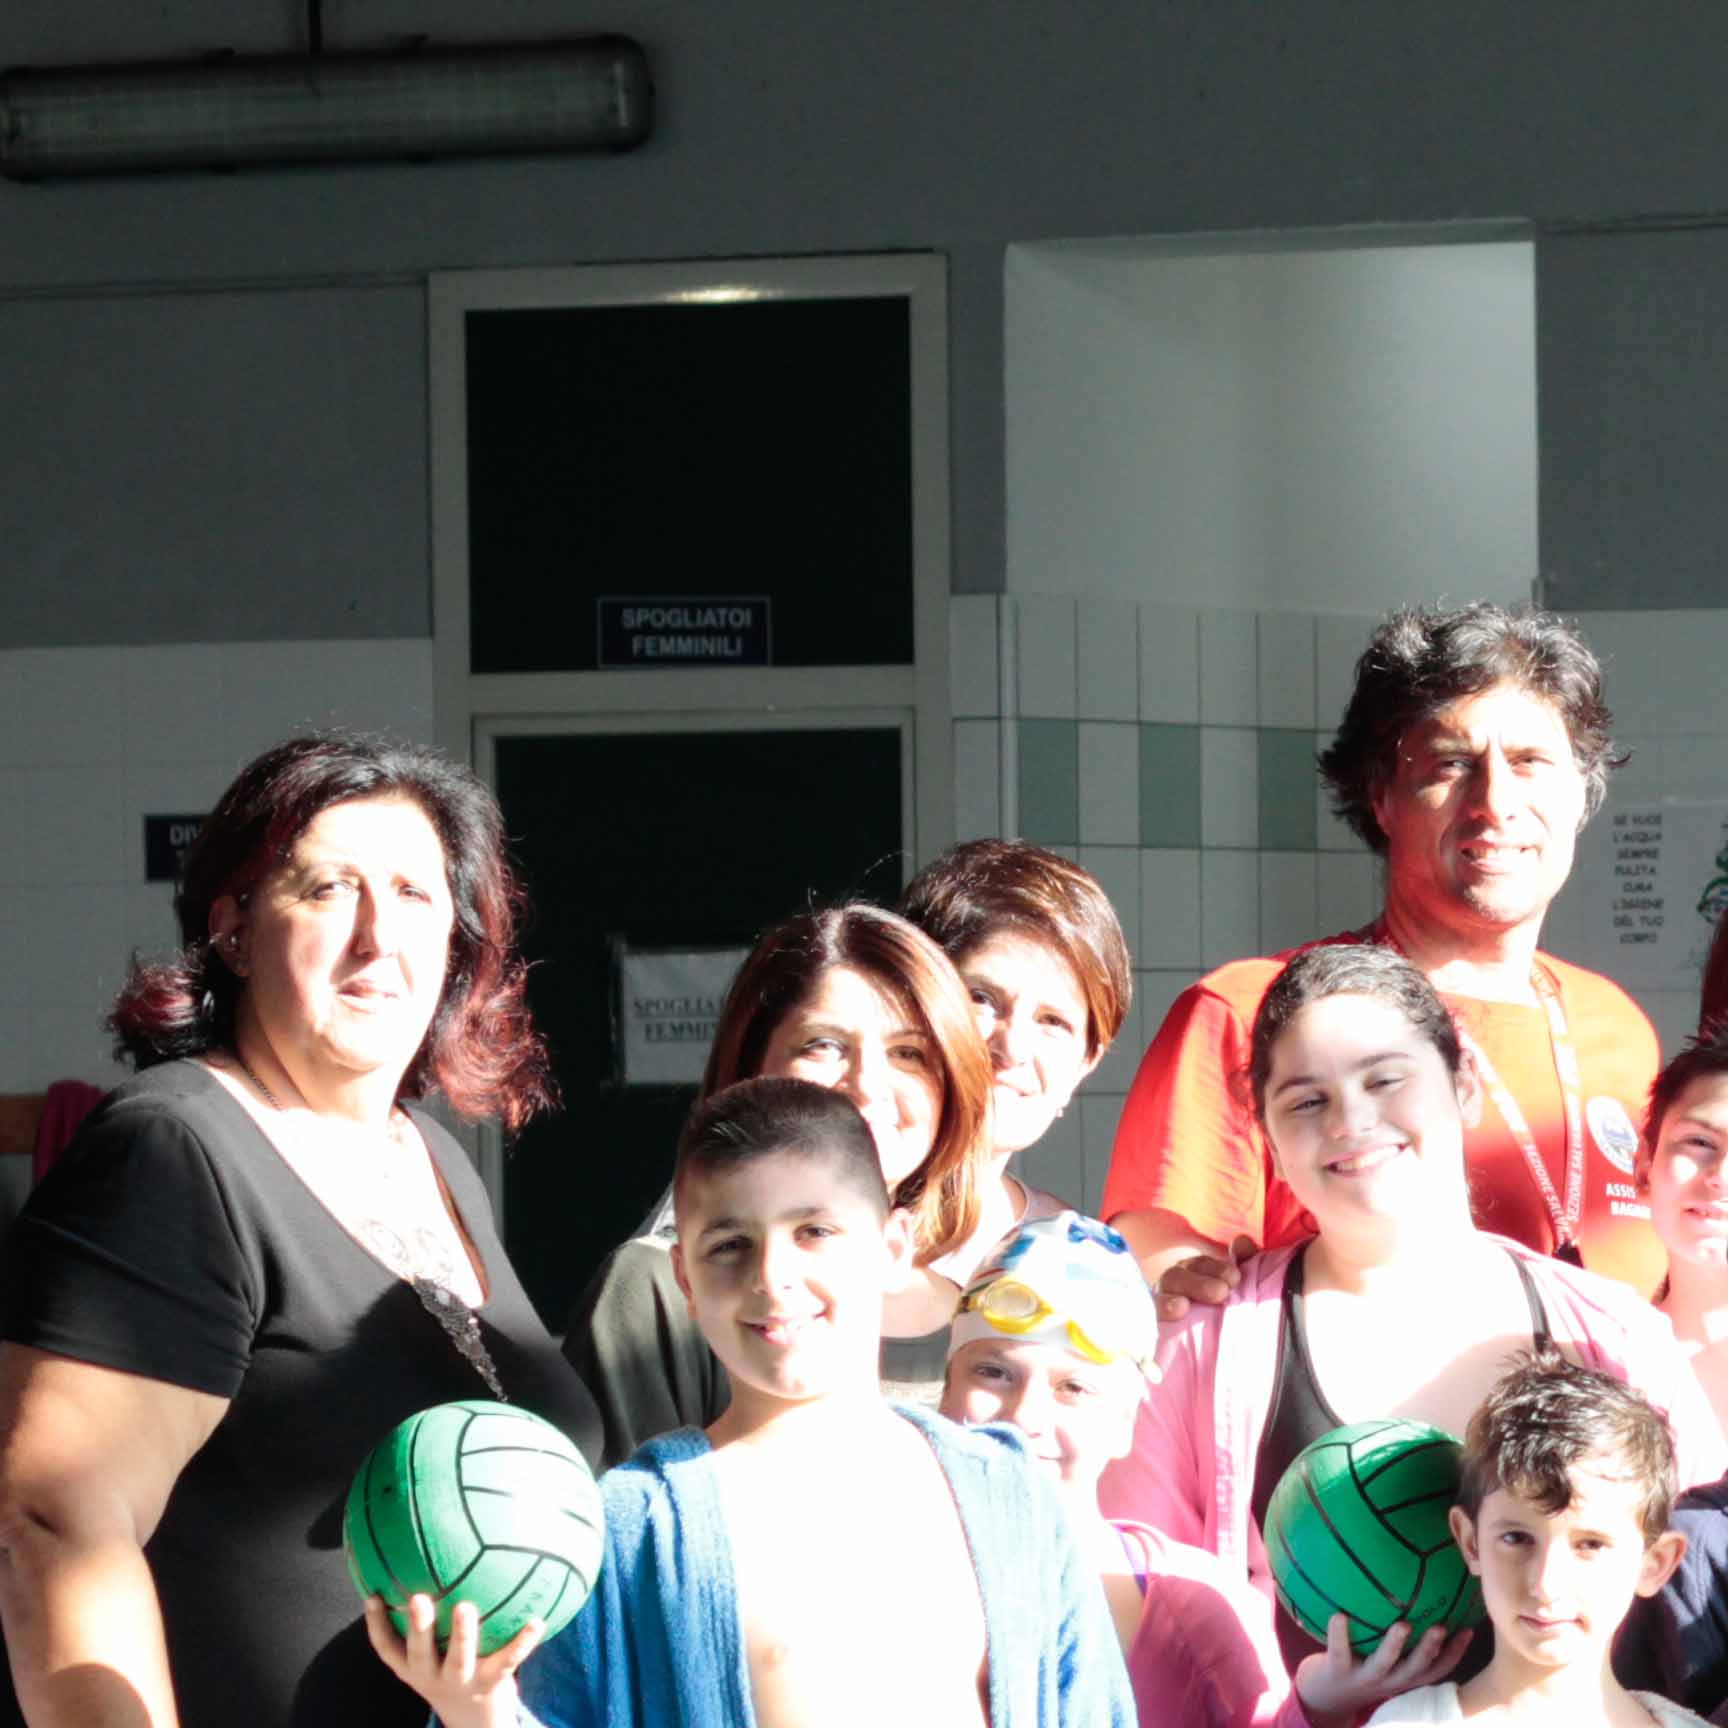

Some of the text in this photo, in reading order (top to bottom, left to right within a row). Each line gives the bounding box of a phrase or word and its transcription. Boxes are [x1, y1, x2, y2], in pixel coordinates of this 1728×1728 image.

[621, 606, 753, 629] SPOGLIATOI
[631, 635, 743, 657] FEMMINILI
[633, 997, 725, 1018] SPOGLIA
